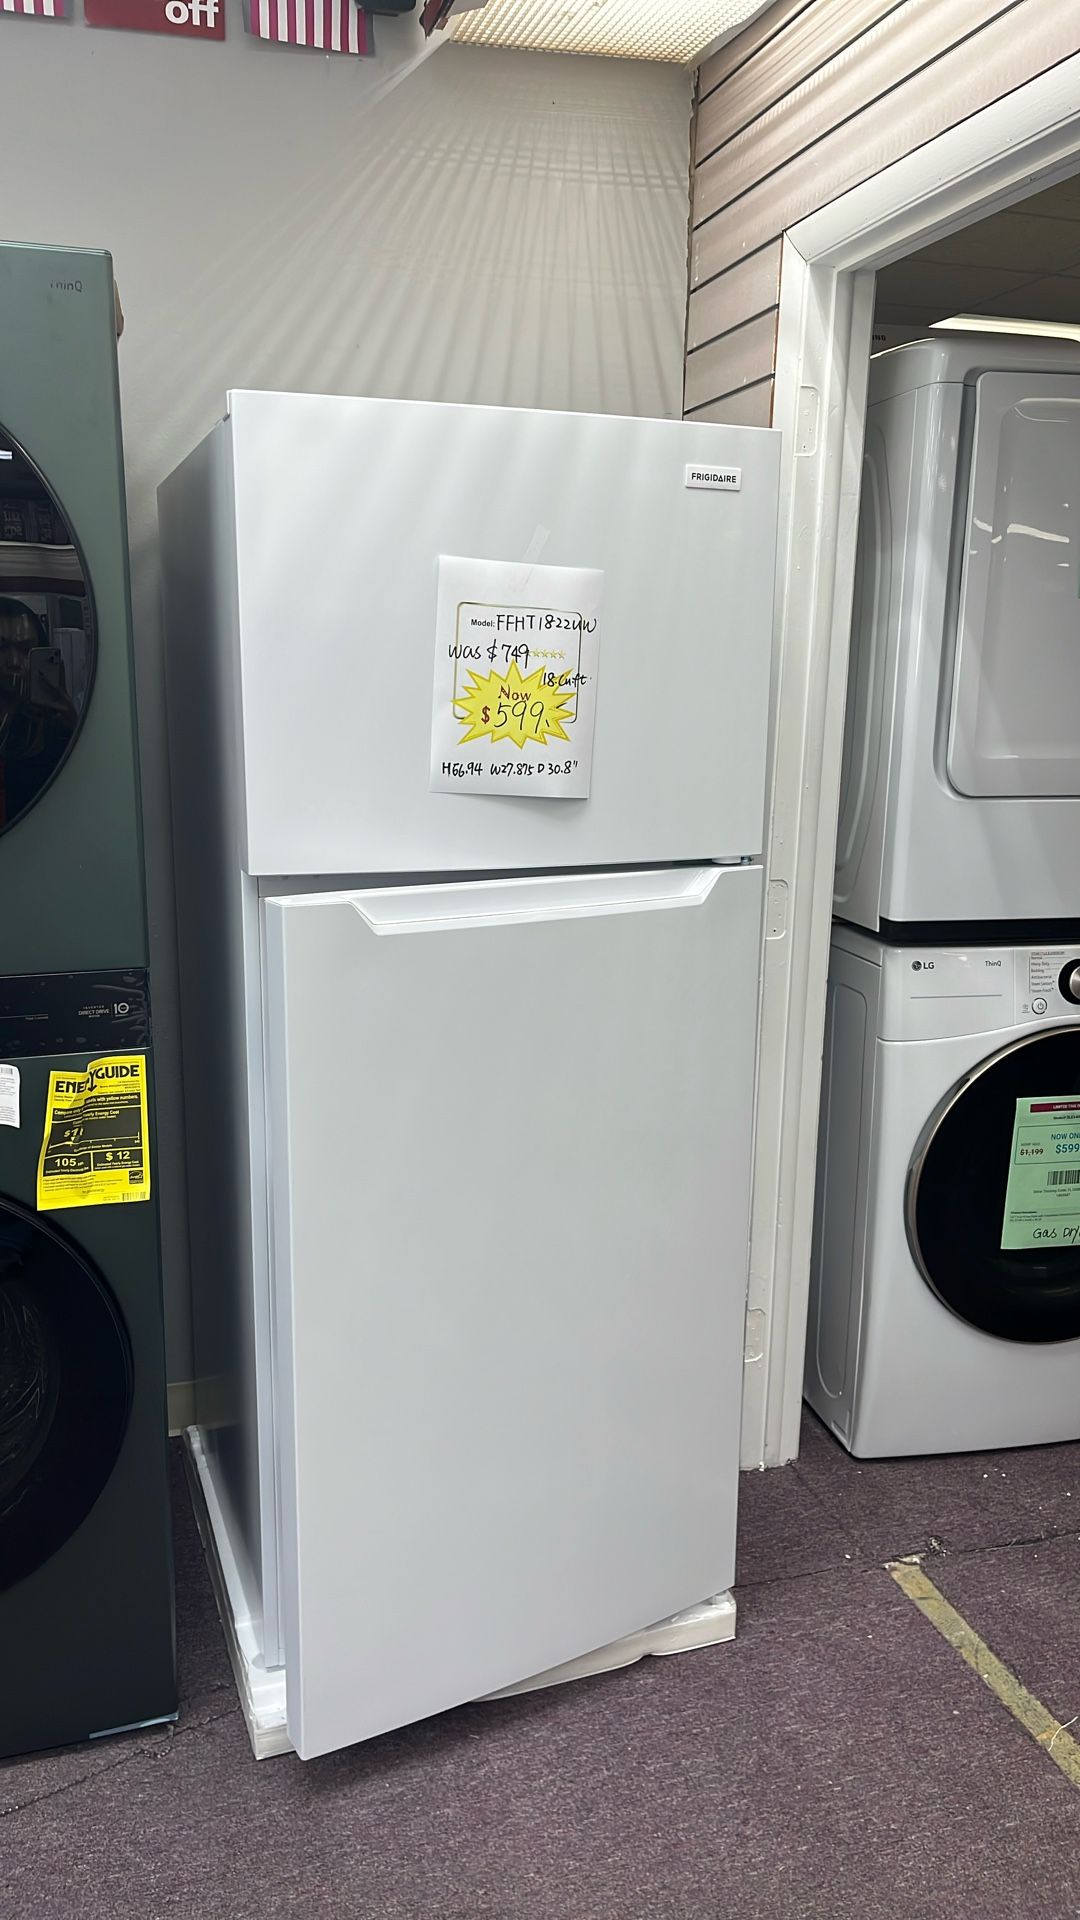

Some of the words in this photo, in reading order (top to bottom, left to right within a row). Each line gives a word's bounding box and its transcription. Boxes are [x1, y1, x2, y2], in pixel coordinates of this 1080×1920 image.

[165, 0, 219, 28] off
[691, 472, 737, 483] FRIGIDAIRE
[471, 618, 495, 628] Model:
[114, 1002, 130, 1014] 10
[1051, 1132, 1067, 1140] NOW
[54, 1158, 77, 1167] 105
[1033, 1228, 1057, 1239] Gas
